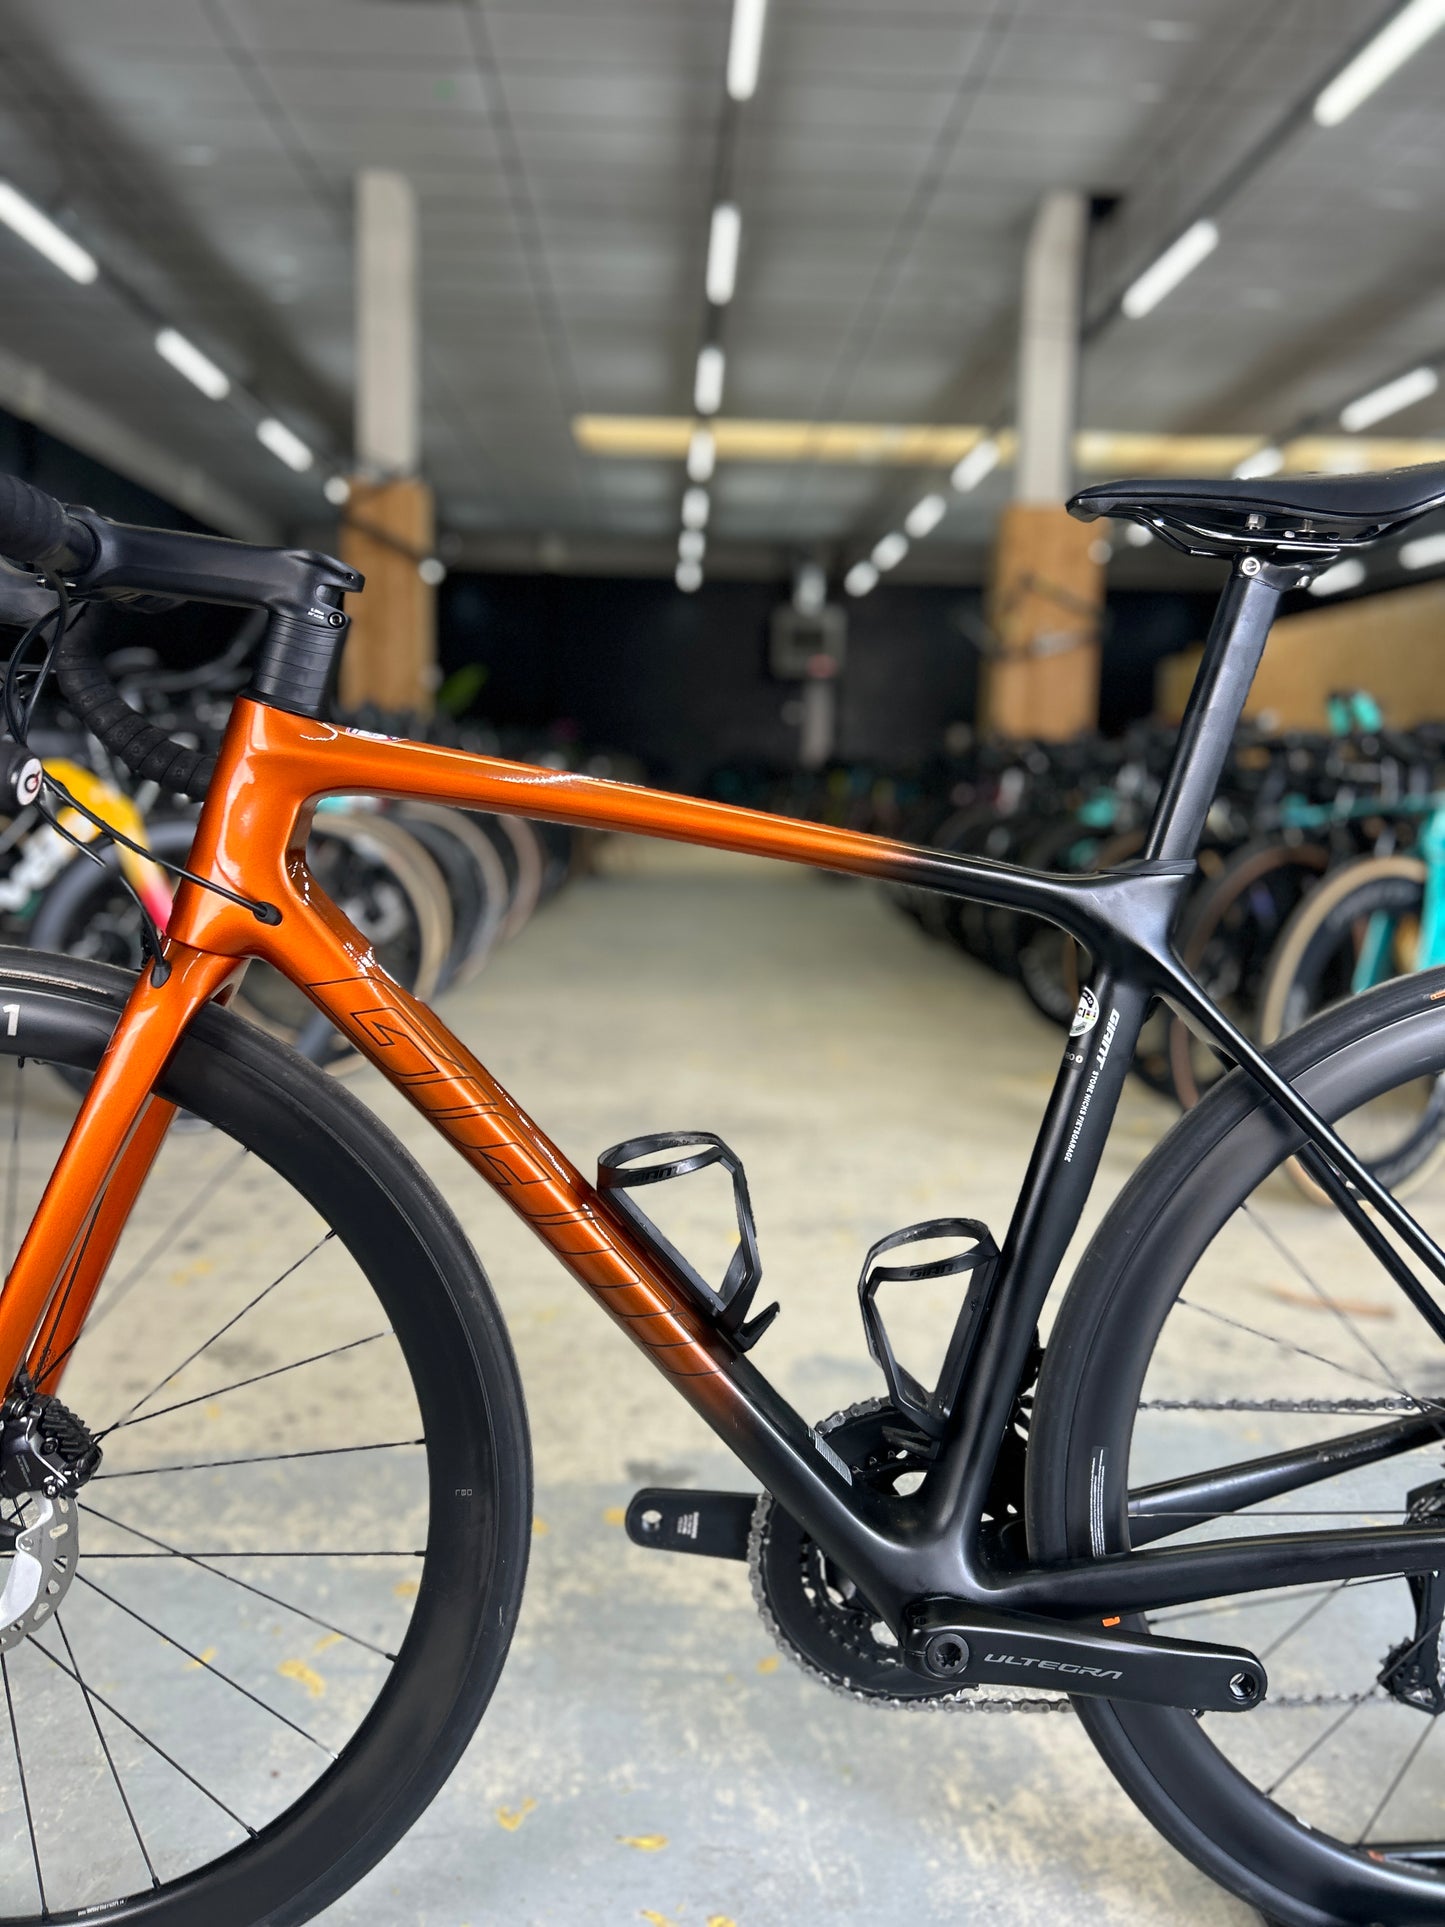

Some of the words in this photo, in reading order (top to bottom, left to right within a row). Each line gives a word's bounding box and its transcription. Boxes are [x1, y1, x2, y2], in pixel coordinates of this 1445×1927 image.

[2, 1003, 20, 1036] 1
[1096, 1008, 1120, 1071] GIANT
[1086, 1070, 1099, 1095] STORE
[304, 976, 722, 1377] GIANT
[984, 1653, 1124, 1680] ULTEGRA
